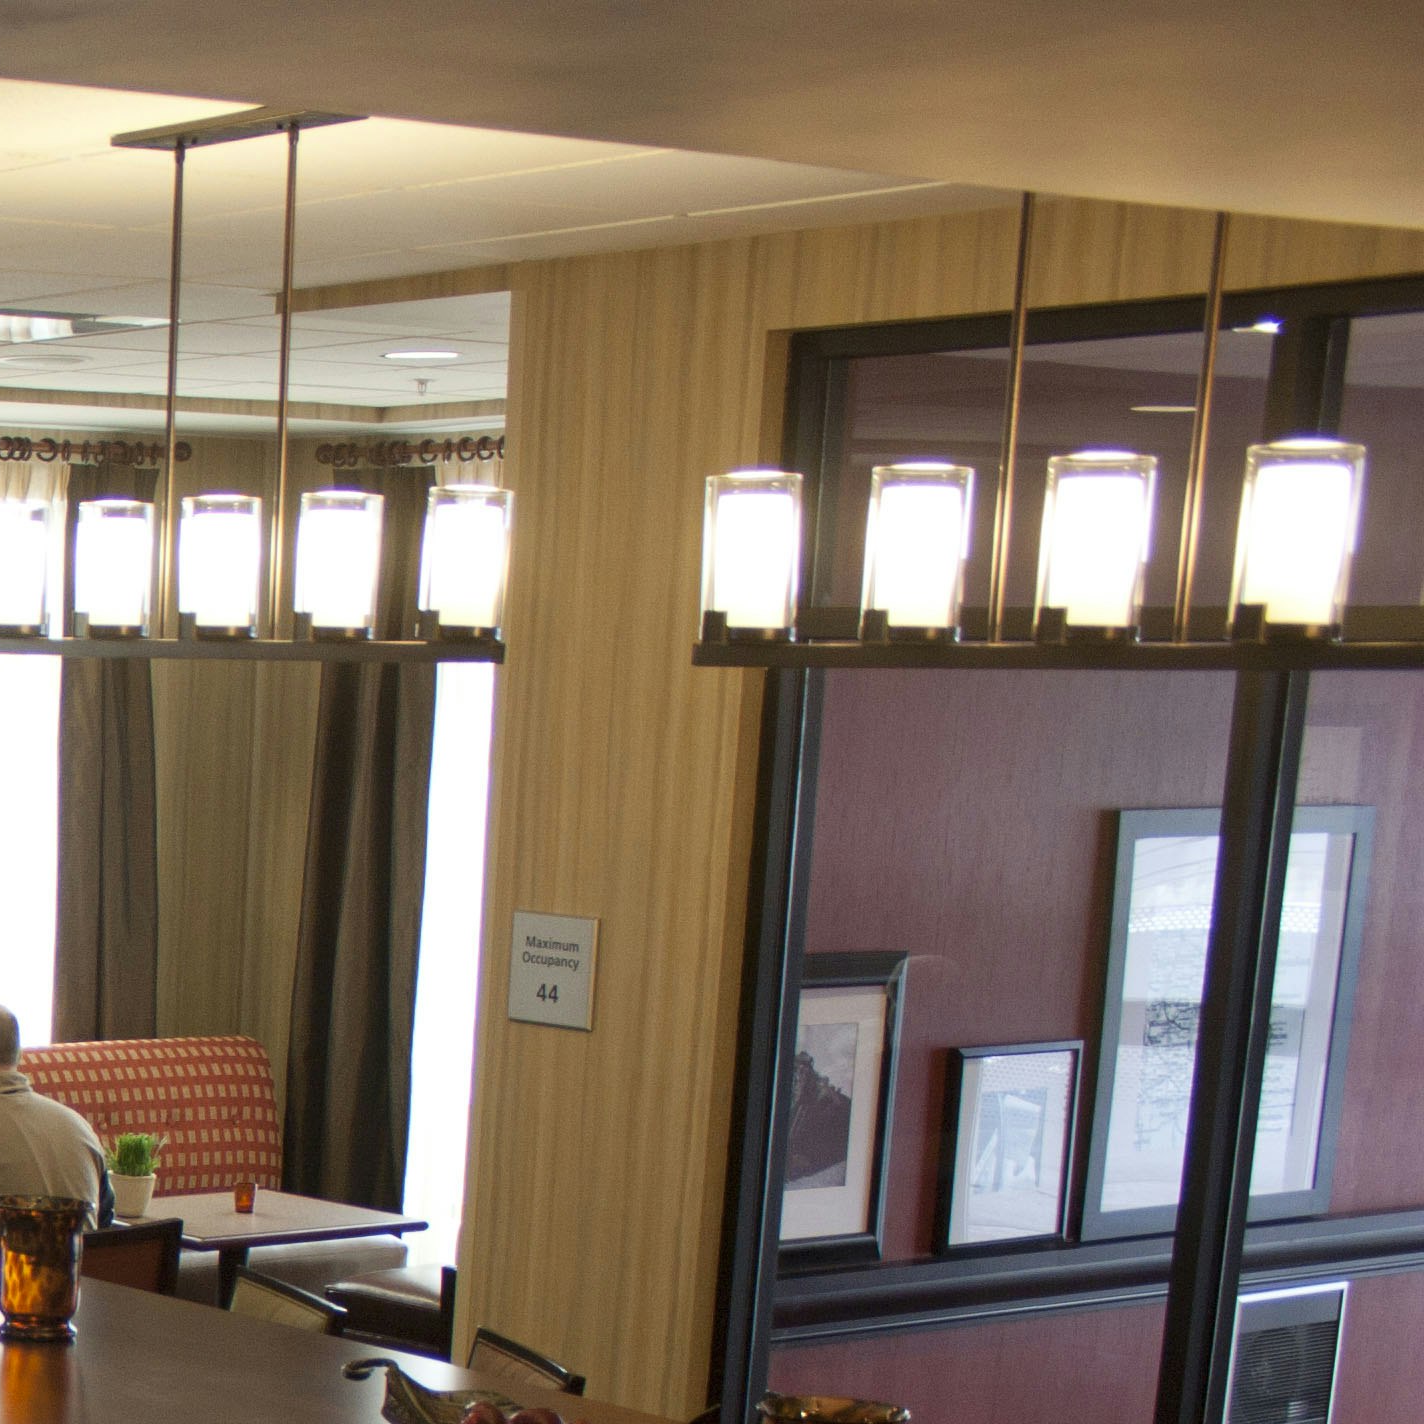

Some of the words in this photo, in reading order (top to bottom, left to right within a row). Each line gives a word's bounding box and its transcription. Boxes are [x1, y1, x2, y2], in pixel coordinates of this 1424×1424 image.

[525, 936, 580, 952] Maximum
[522, 951, 580, 971] Occupancy
[536, 983, 559, 1003] 44
